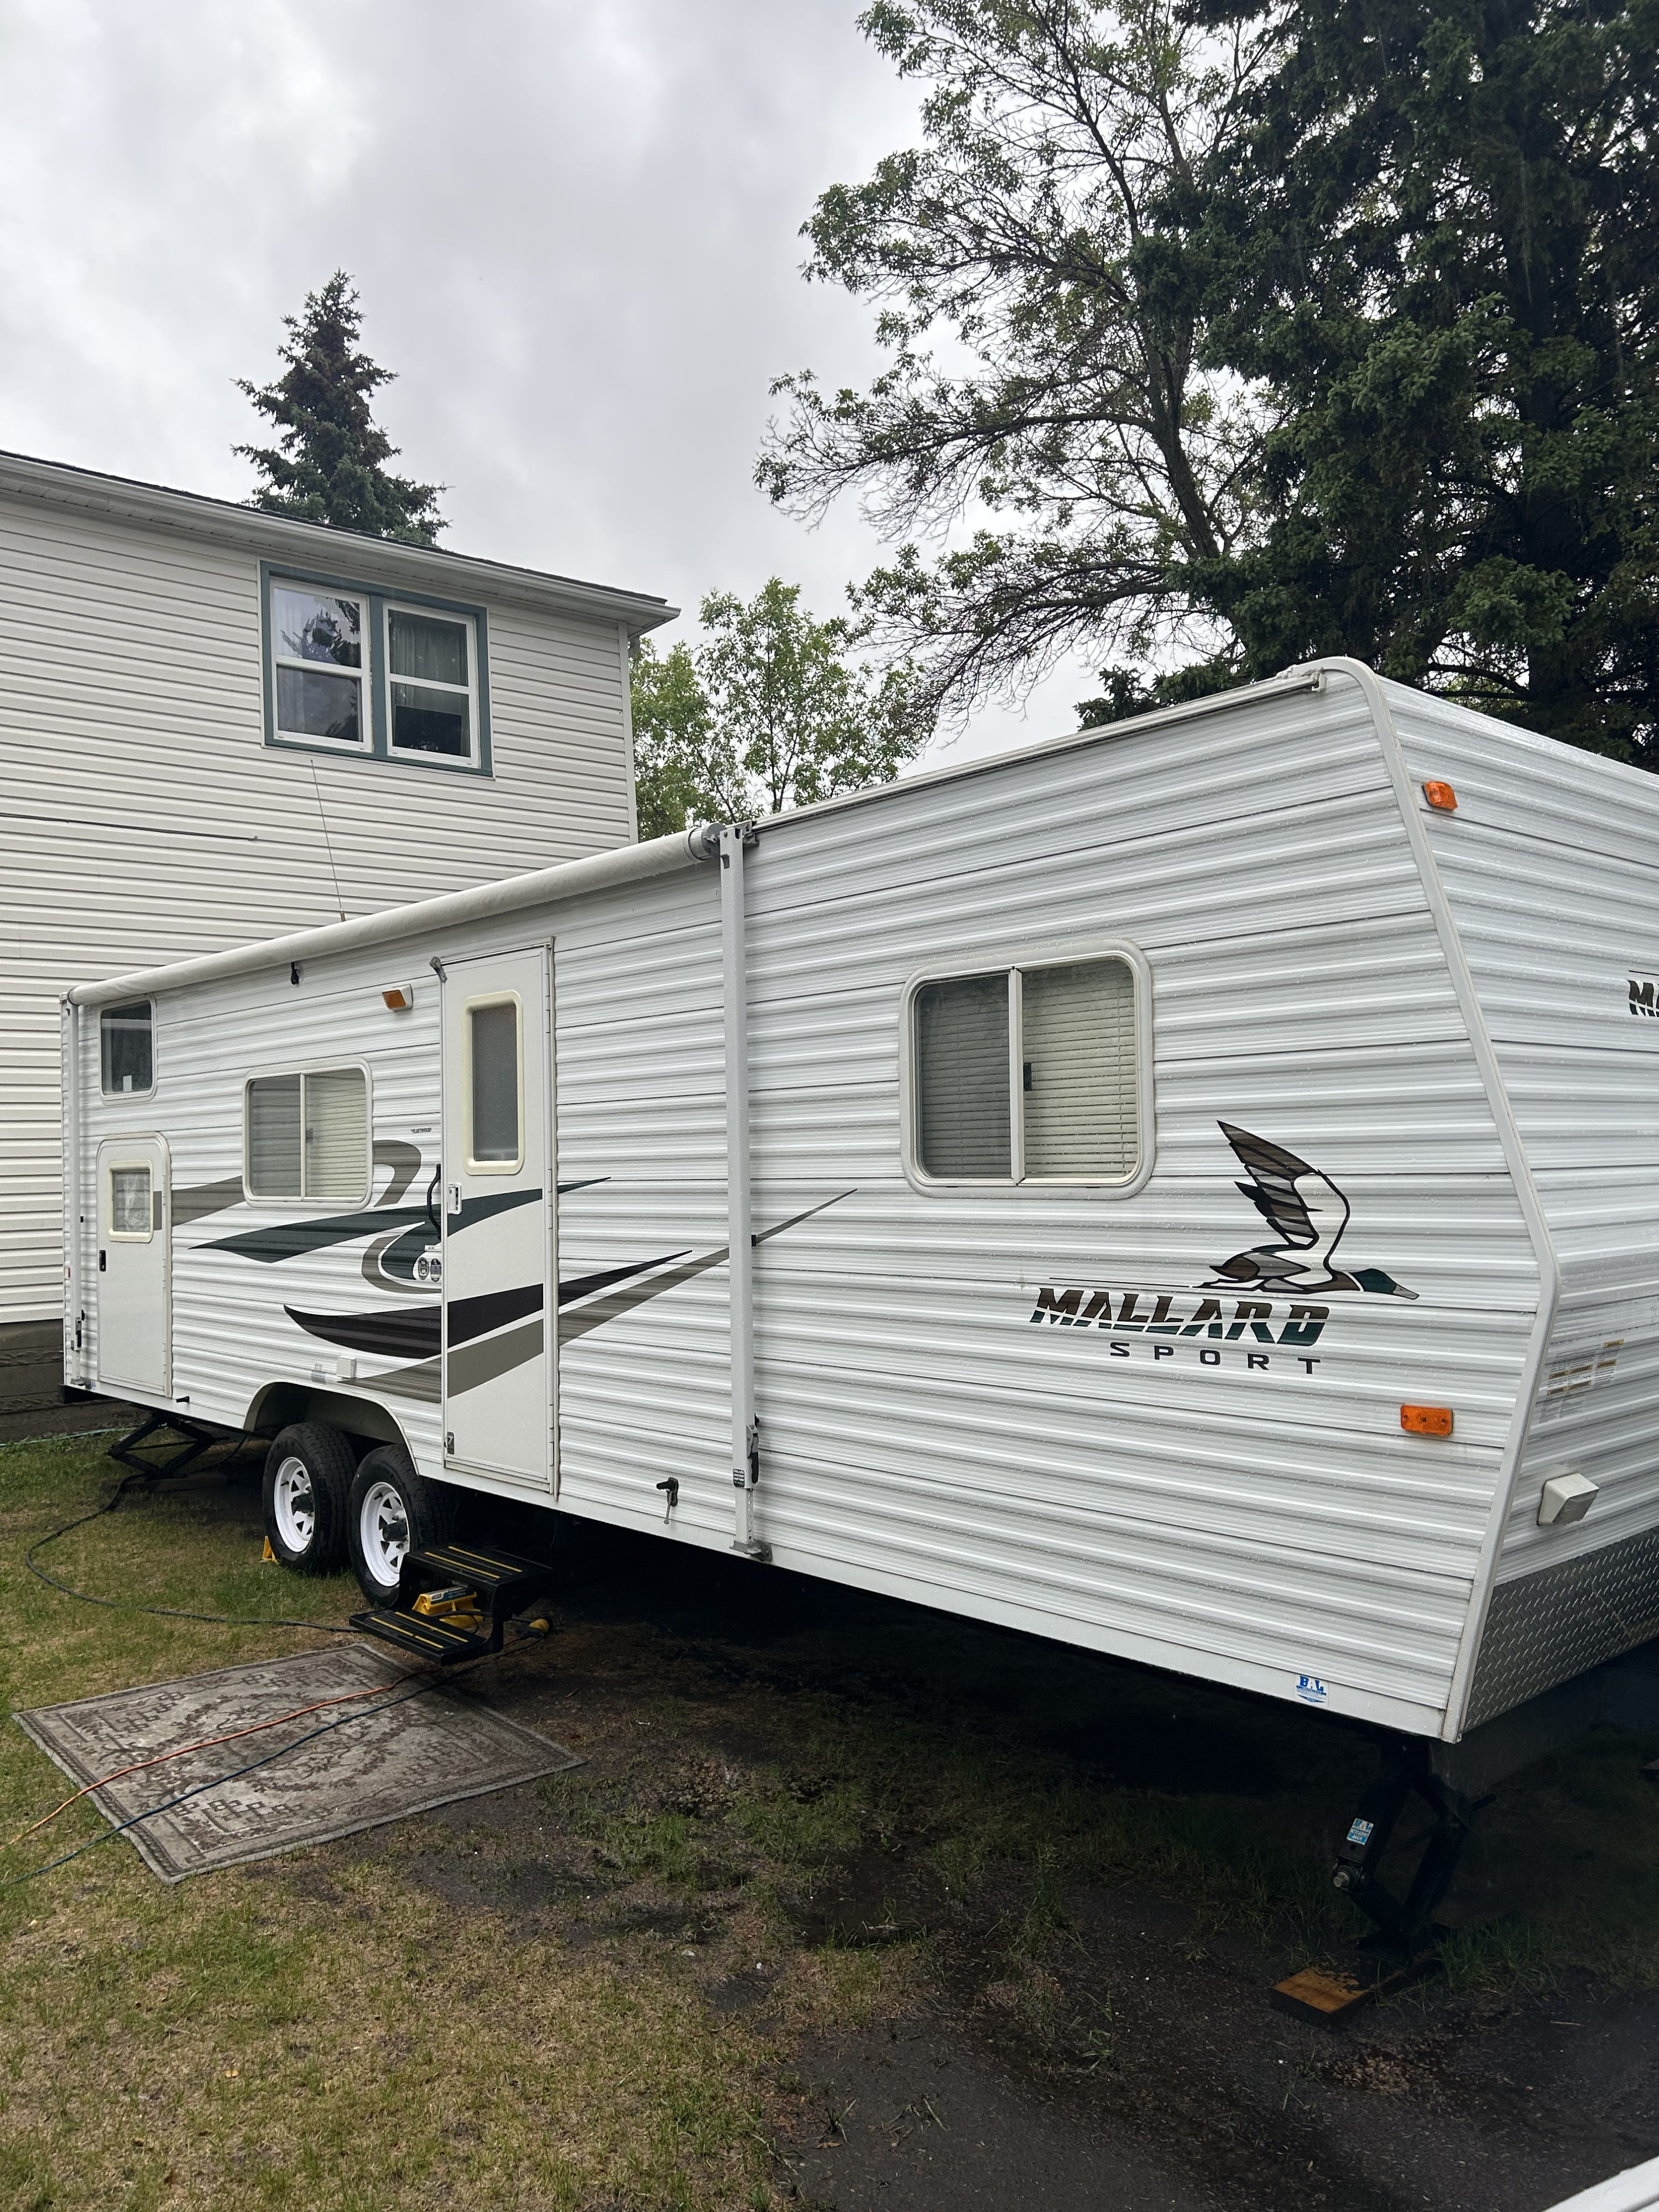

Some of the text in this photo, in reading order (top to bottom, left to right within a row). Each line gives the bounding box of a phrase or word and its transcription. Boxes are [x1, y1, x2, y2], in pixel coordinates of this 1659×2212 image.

[1627, 979, 1659, 1018] M
[1029, 1287, 1331, 1347] MALLARD
[1110, 1342, 1322, 1375] SPORT
[1300, 1676, 1324, 1692] BAL
